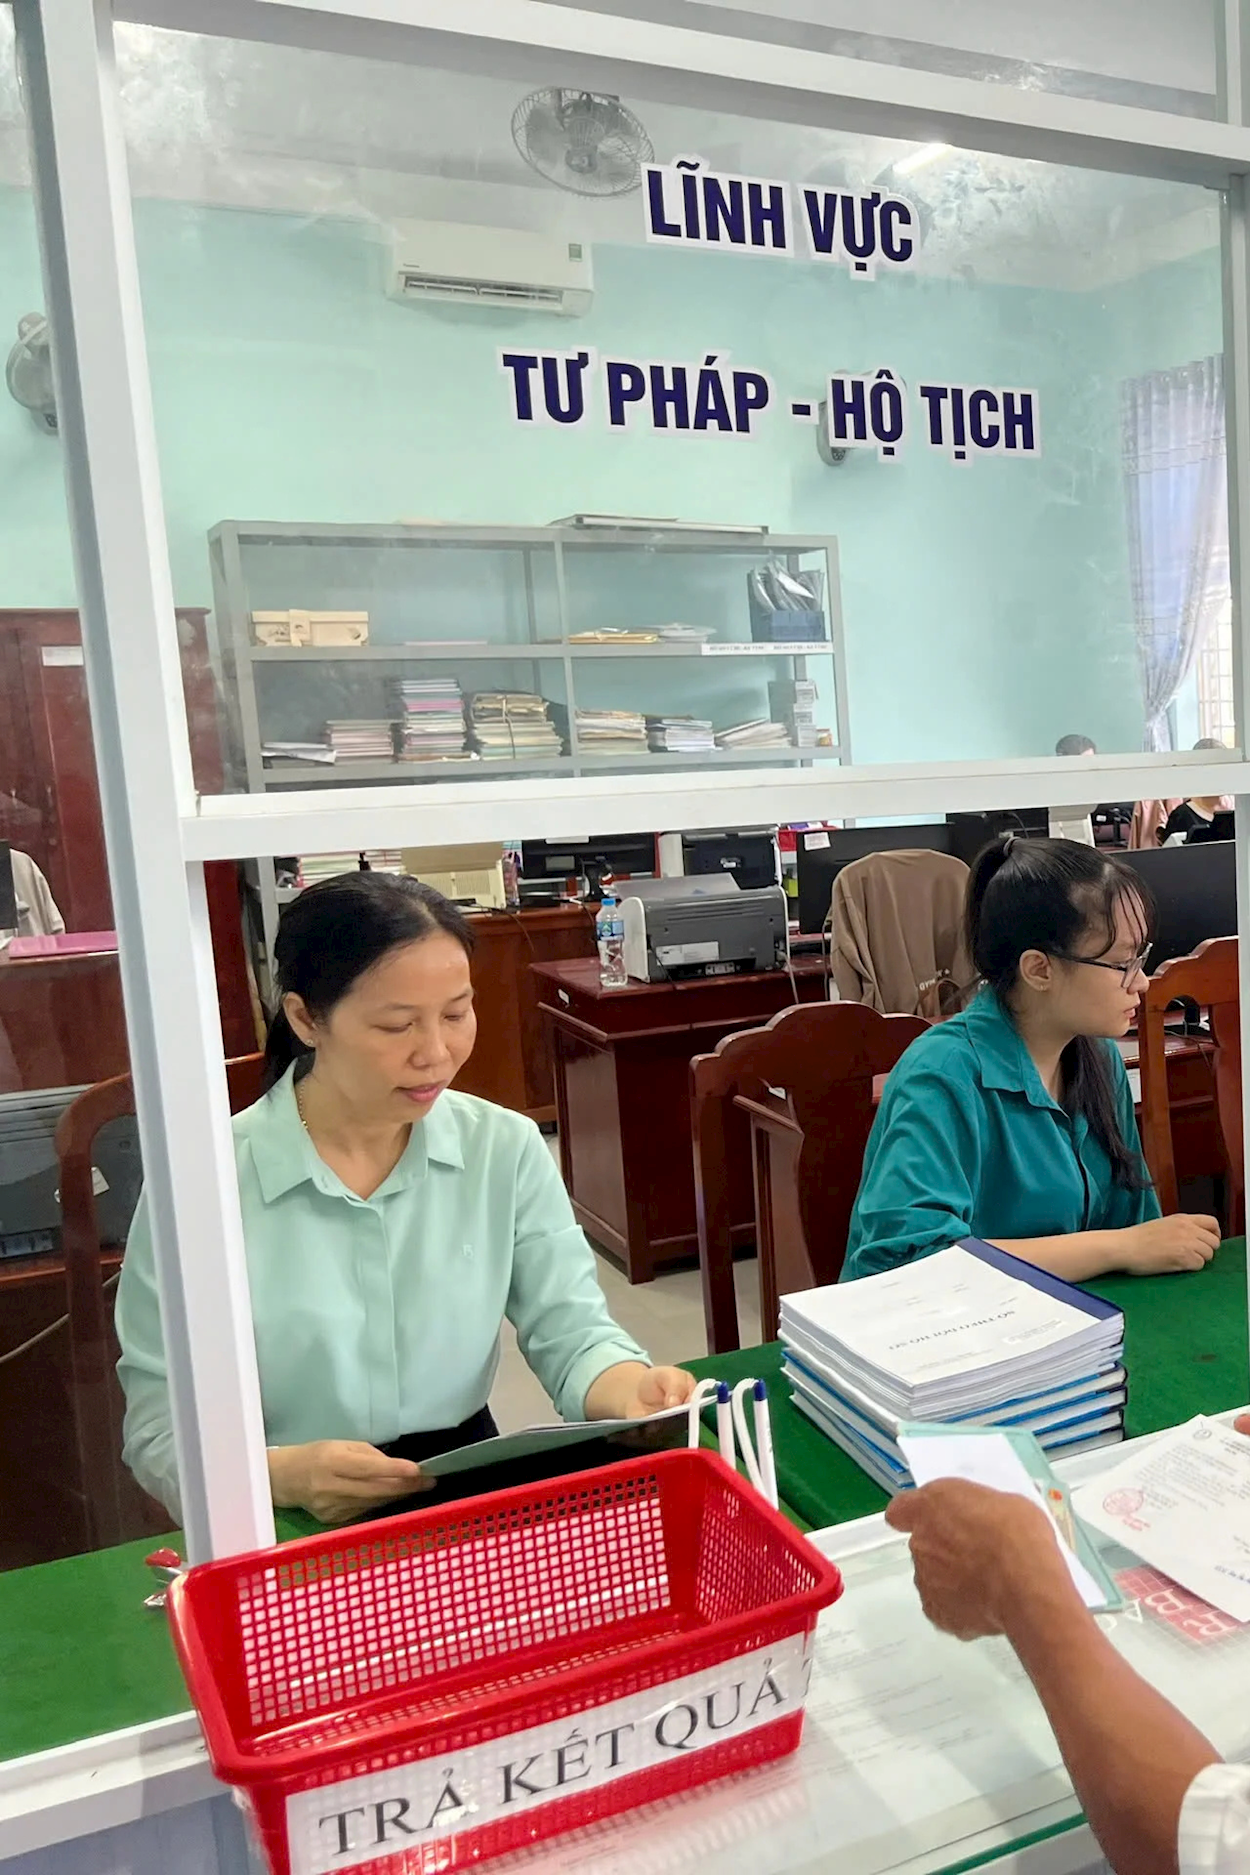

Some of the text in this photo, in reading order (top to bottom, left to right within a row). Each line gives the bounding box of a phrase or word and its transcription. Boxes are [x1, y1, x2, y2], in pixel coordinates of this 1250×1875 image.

[647, 160, 913, 271] LĨNH VỰC
[502, 352, 589, 423] TƯ
[606, 355, 769, 433] PHÁP
[831, 369, 903, 456] HỘ
[921, 386, 1034, 460] TỊCH
[319, 1768, 478, 1855] TRẢ
[500, 1727, 635, 1804] KẾT
[655, 1657, 788, 1750] QUẢ
